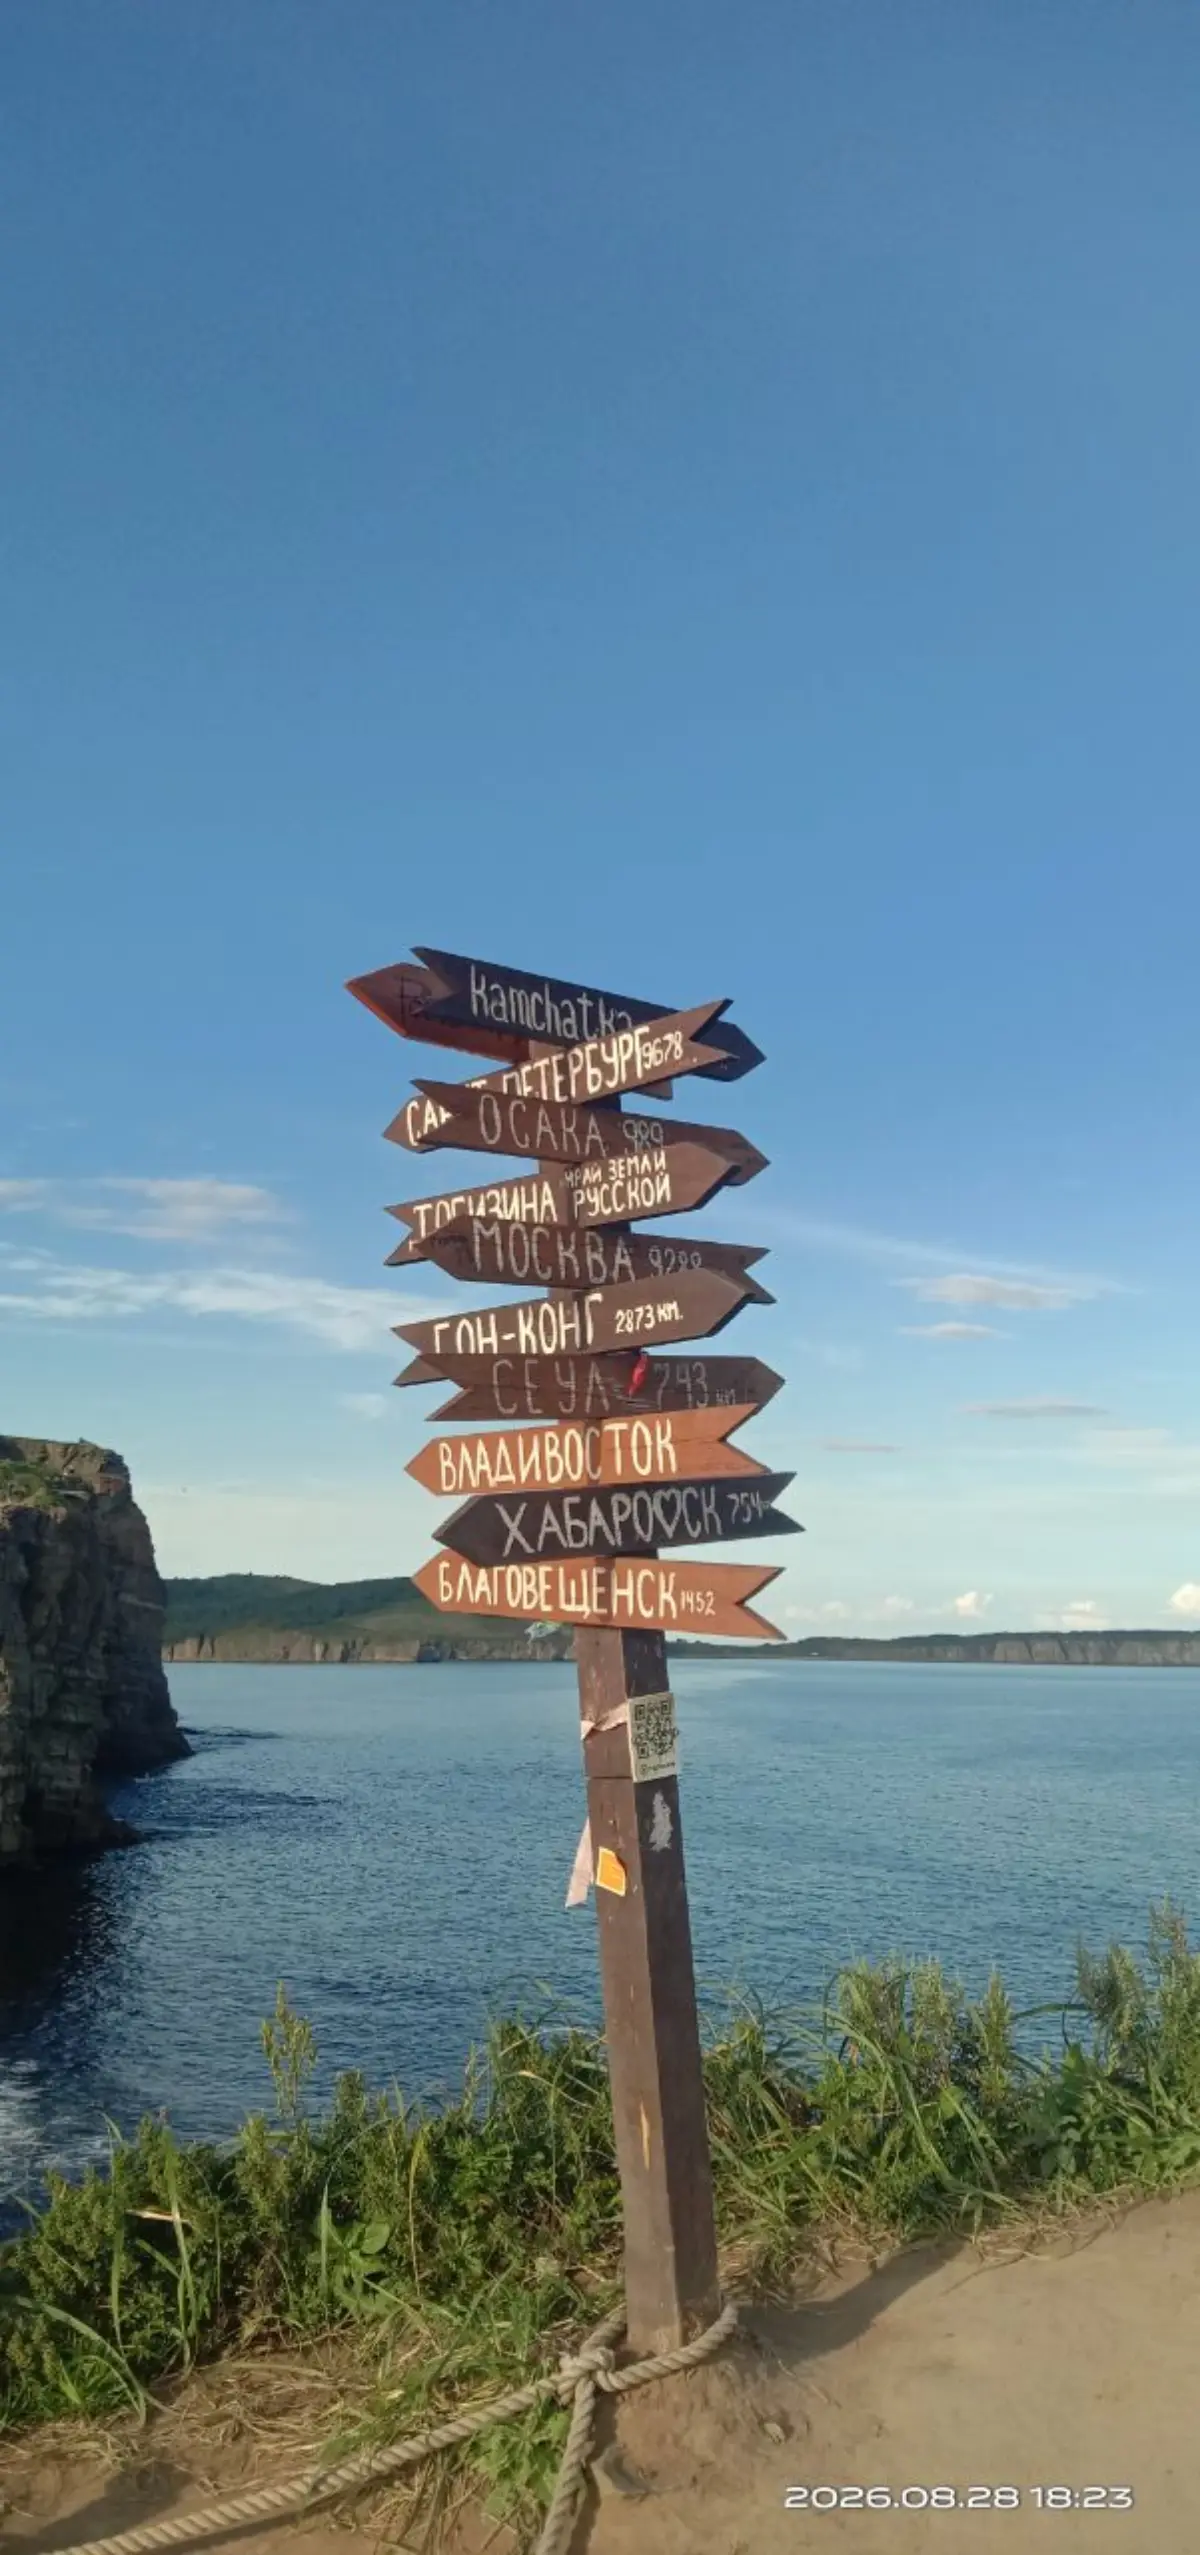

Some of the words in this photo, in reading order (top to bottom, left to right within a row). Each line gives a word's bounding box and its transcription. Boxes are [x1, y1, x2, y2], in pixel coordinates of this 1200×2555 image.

[642, 1031, 684, 1070] 9678
[478, 1094, 606, 1157] ОСАКА
[608, 1150, 667, 1180] ЗЕМЛИ
[573, 1171, 672, 1219] РУССКОЙ
[472, 1217, 636, 1285] МОСКВА
[433, 1293, 604, 1354] ГОН-КОНГ
[492, 1358, 611, 1415] СЕУЛ
[654, 1361, 709, 1411] 743
[439, 1418, 678, 1492] ВЛАДИВОСТОК
[726, 1490, 763, 1524] 754
[438, 1560, 678, 1620] БЛАГОВЕЩЕНСК
[681, 1590, 716, 1616] 1452
